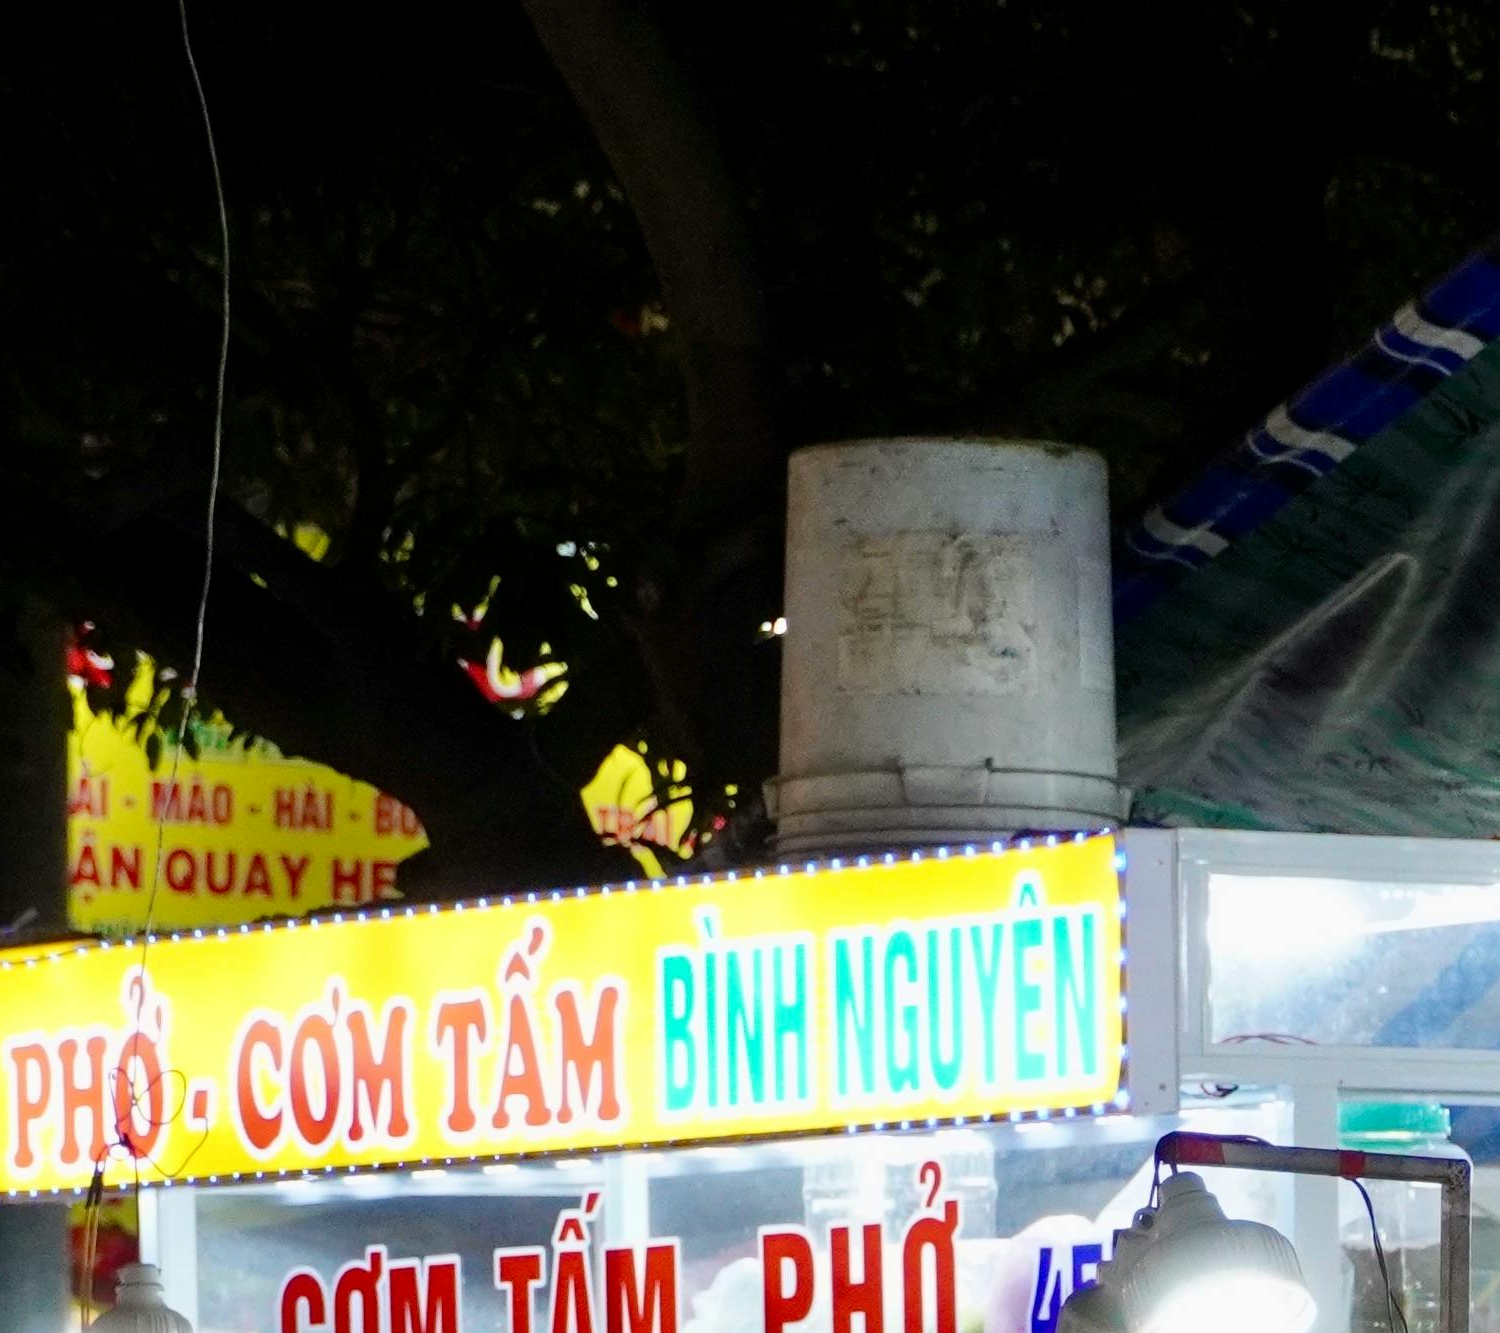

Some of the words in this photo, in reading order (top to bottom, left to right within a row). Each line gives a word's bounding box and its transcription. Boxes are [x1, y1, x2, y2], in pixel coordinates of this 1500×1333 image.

[165, 846, 310, 903] QUAY
[8, 975, 164, 1170] PHỞ
[236, 986, 410, 1150] CƠM
[434, 925, 621, 1133] TẤM
[663, 915, 808, 1112] BÌNH
[834, 882, 1099, 1097] NGUYÊN
